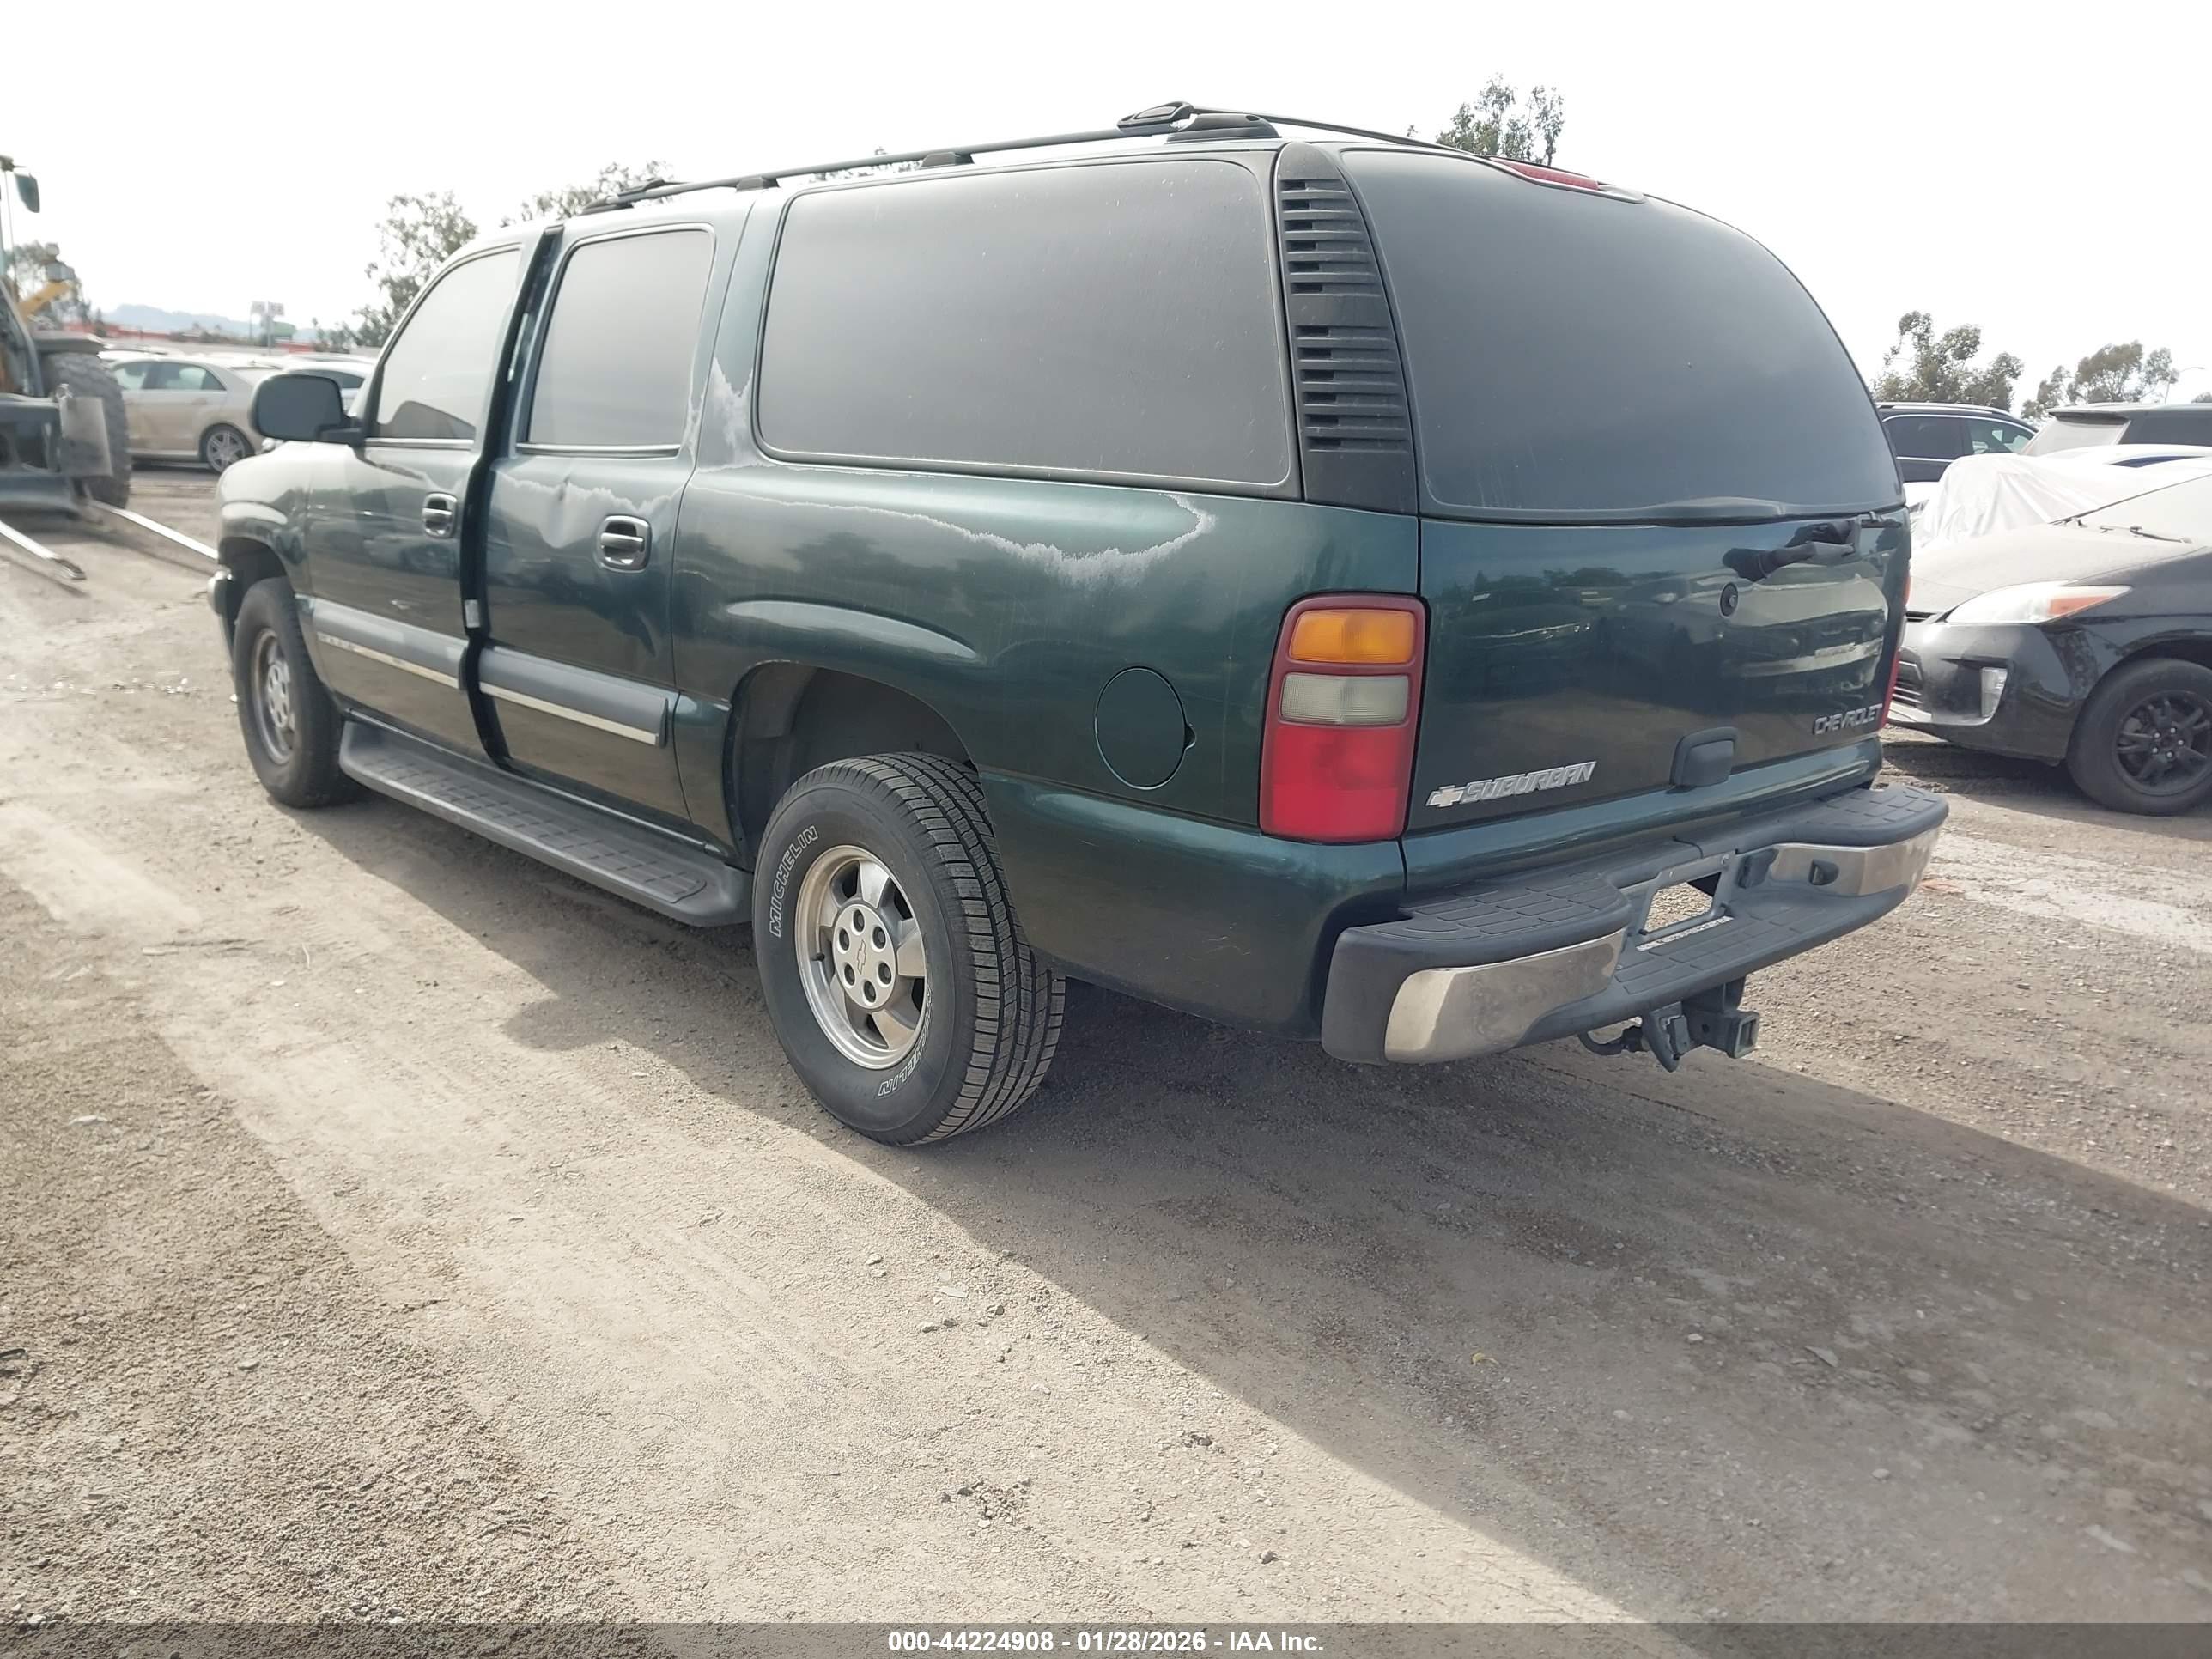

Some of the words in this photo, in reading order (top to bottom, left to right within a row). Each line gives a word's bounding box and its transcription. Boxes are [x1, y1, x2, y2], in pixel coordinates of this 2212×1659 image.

[1812, 702, 1883, 736] CHEVROLET
[1459, 761, 1596, 805] SUBURBAN
[769, 825, 818, 938] MICHELIN
